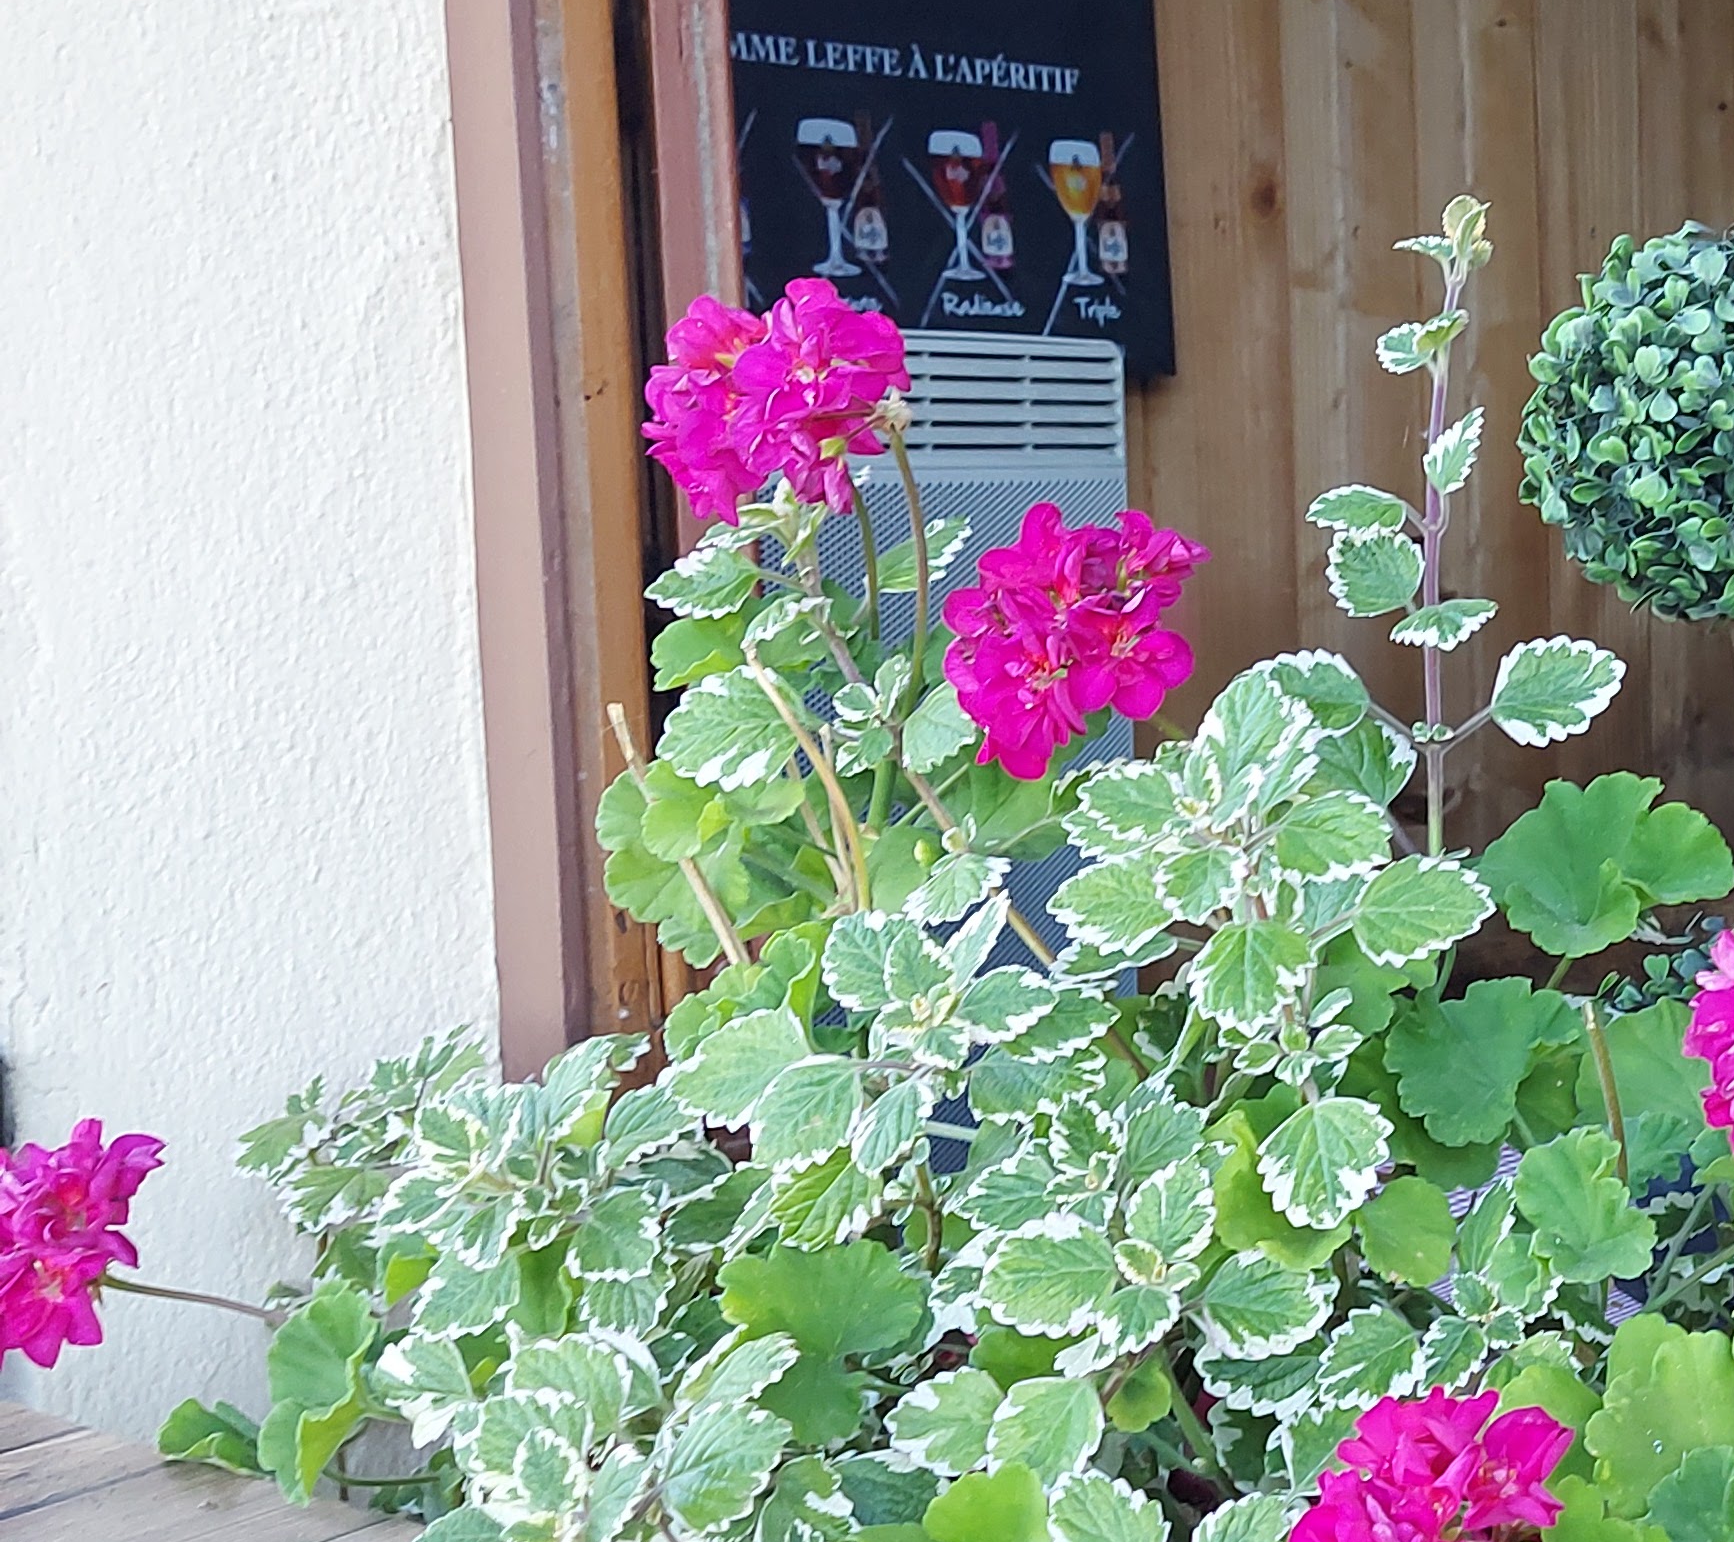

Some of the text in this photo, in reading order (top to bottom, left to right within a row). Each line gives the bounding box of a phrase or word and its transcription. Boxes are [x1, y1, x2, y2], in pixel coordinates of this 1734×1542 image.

[730, 32, 1080, 95] MME LEFFE À L'APÉRITIF
